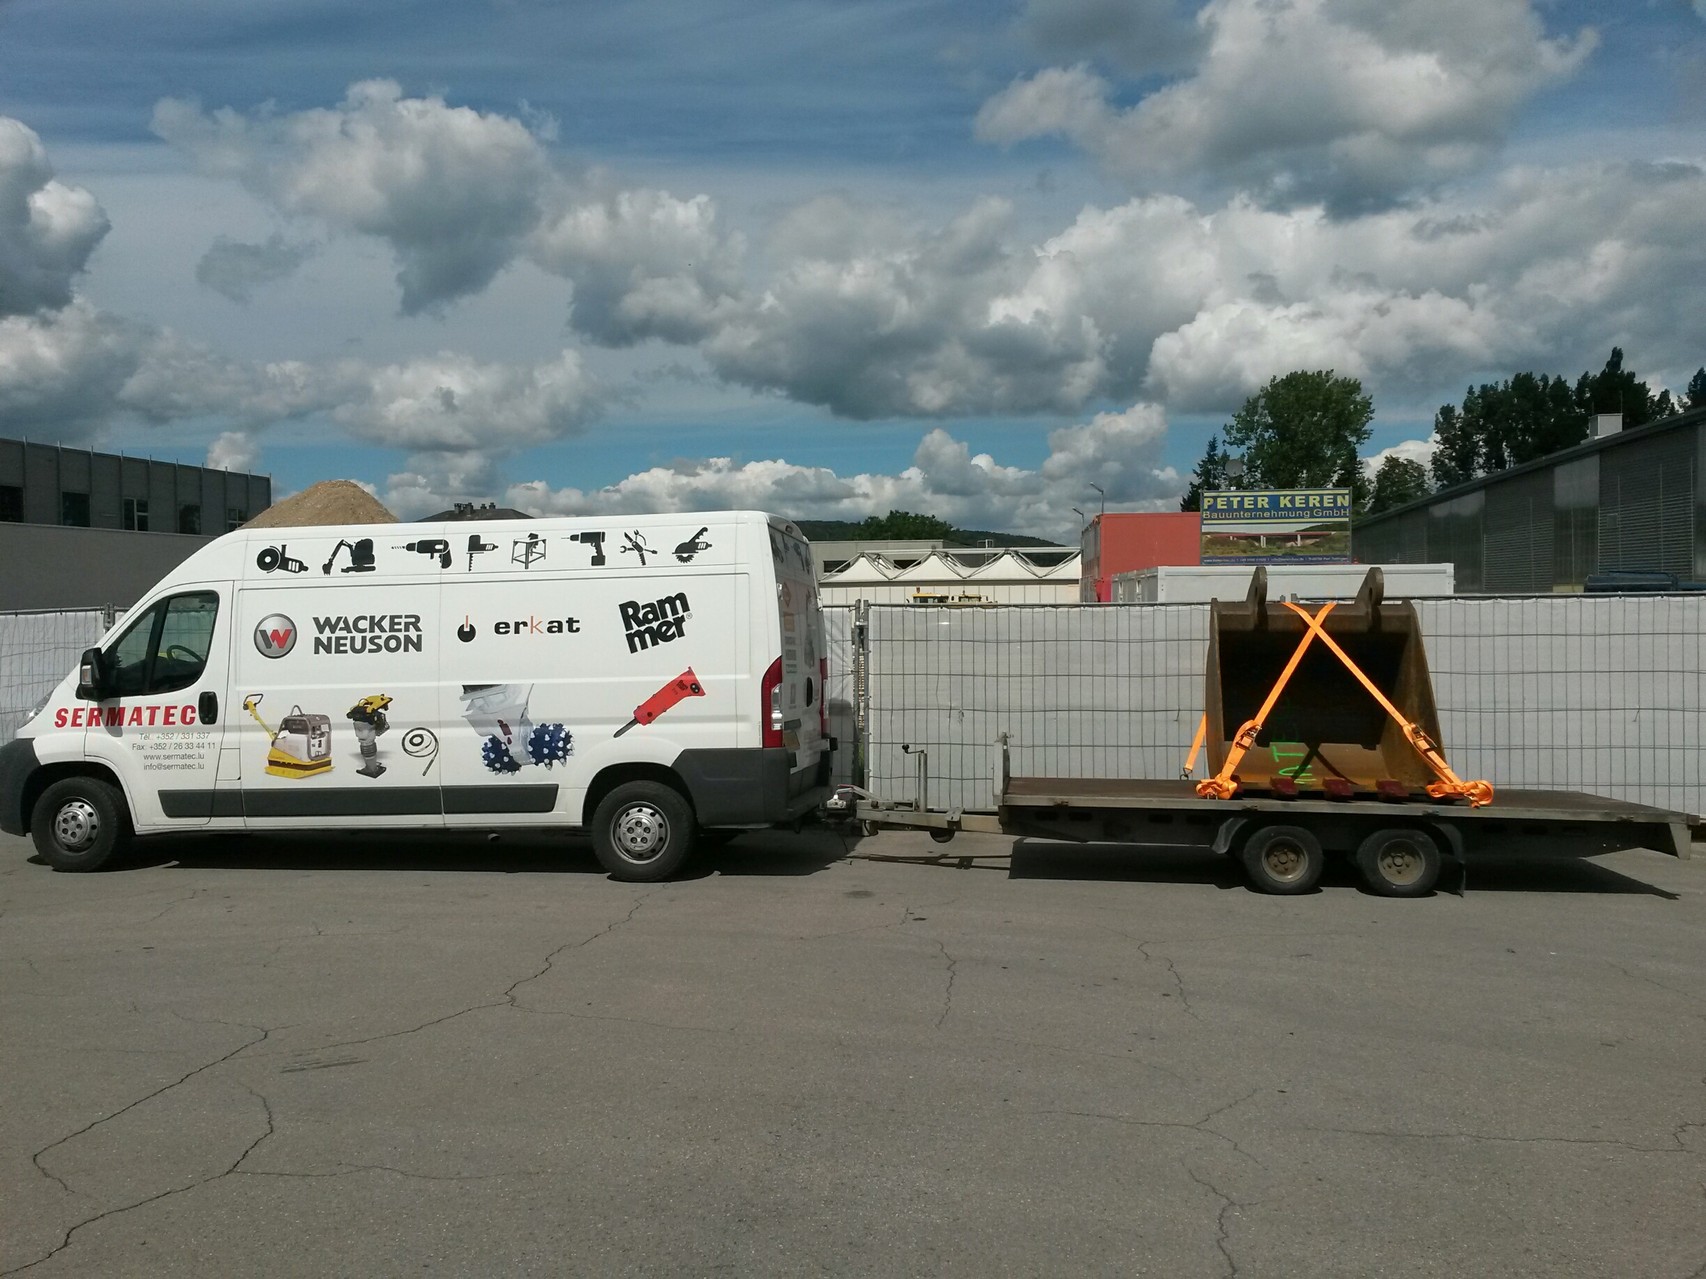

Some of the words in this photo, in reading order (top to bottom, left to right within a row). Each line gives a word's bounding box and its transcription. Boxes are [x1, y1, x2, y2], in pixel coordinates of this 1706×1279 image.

[1203, 496, 1269, 509] PETER
[1279, 495, 1349, 508] KEREN
[1202, 510, 1310, 519] Bauunternehmung
[1313, 508, 1349, 517] GmbH
[618, 592, 690, 632] Ram
[312, 614, 422, 634] WACKER
[494, 615, 581, 635] erkat
[313, 634, 422, 654] NEUSON
[54, 705, 197, 728] SERMATEC
[156, 732, 175, 741] +352
[180, 732, 194, 740] 331
[196, 731, 210, 740] 337
[149, 742, 167, 751] +352
[173, 742, 183, 750] 26
[184, 742, 194, 750] 33
[195, 742, 205, 750] 44
[208, 741, 216, 750] 11
[143, 752, 205, 761] www.sermatec.lu
[144, 762, 205, 771] info@sermatec.lu
